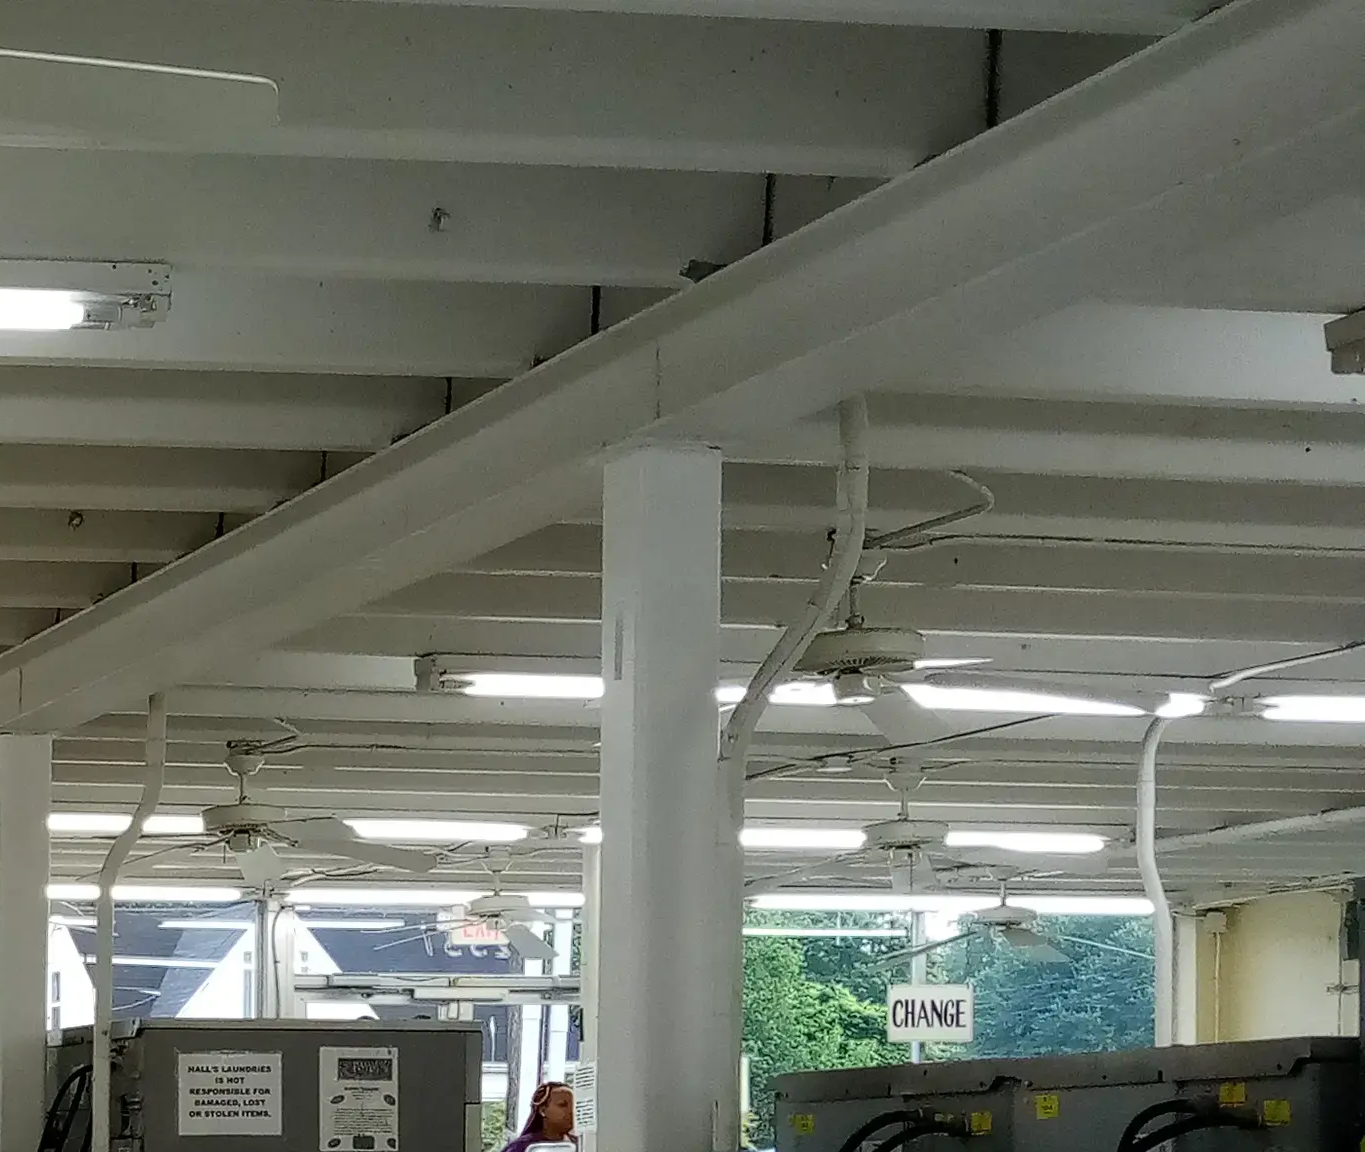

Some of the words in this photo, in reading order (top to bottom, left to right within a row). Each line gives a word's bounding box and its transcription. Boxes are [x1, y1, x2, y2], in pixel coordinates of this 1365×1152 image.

[892, 998, 967, 1028] CHANGE
[221, 1065, 272, 1073] LAUNDRIES
[189, 1088, 251, 1096] RESPONSIBLE
[253, 1088, 272, 1096] FOR
[194, 1099, 241, 1107] DAMAGED,
[189, 1110, 202, 1118] OR
[204, 1110, 240, 1118] STOLEN
[241, 1110, 272, 1118] ITEMS.
